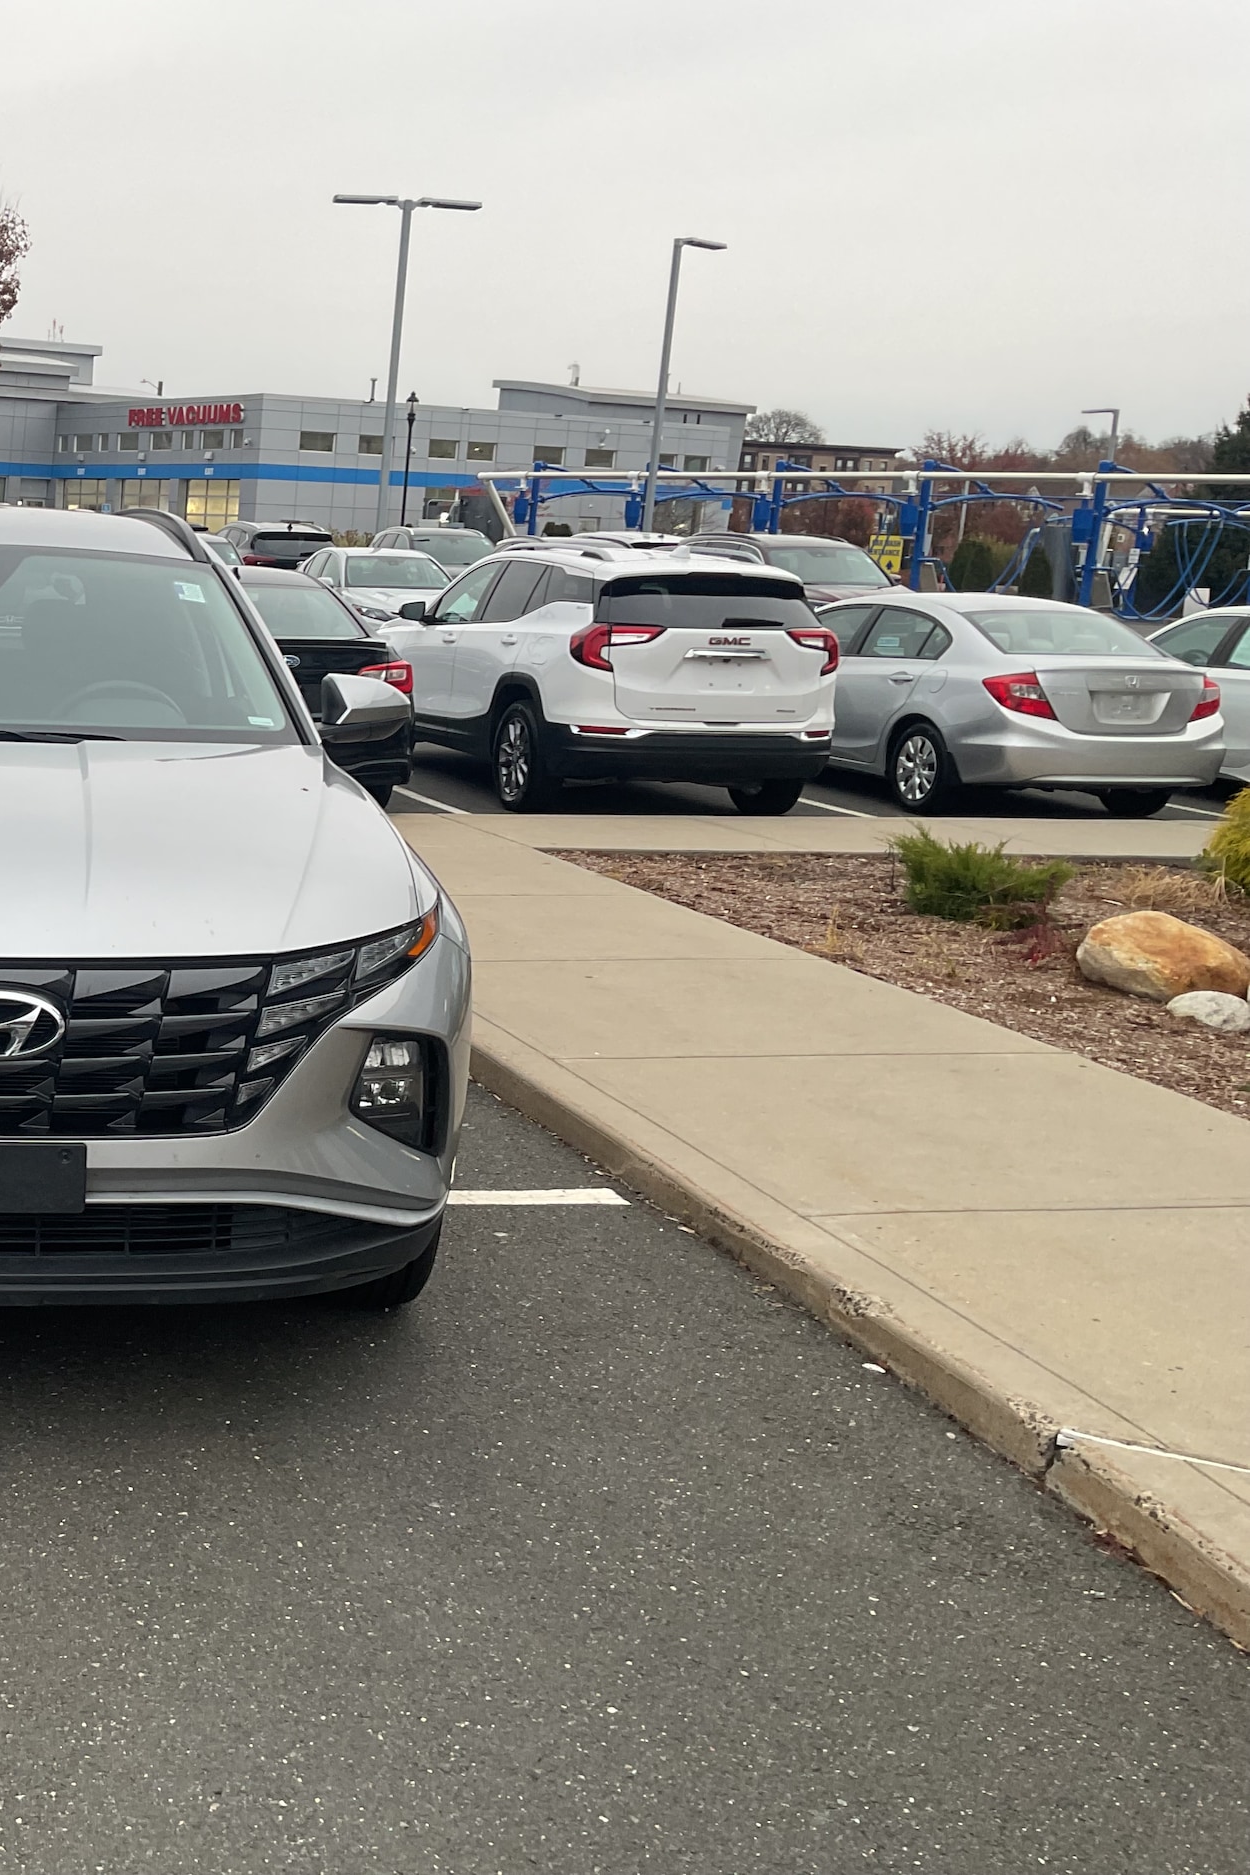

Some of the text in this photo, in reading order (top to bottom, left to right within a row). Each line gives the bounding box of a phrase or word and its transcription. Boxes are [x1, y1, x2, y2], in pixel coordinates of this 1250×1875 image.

[128, 403, 244, 427] FREE VACUUMS
[708, 637, 751, 646] GMC
